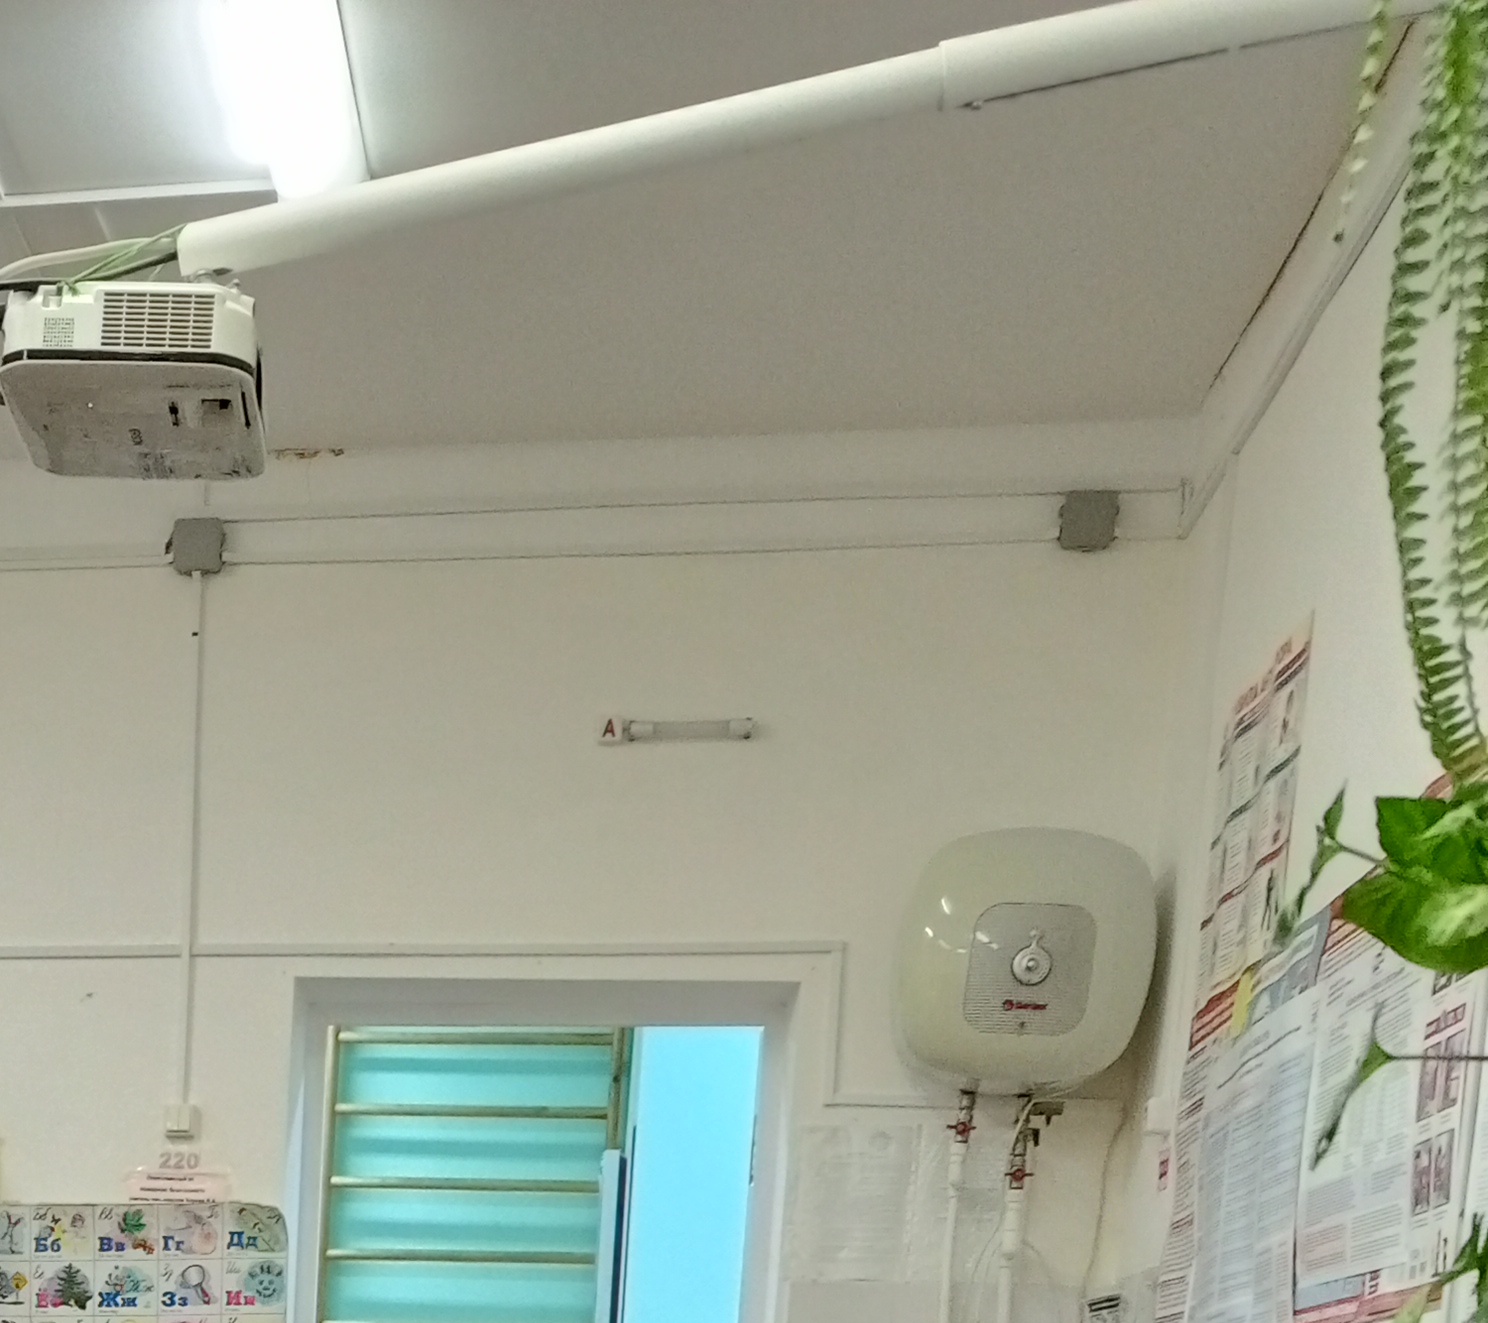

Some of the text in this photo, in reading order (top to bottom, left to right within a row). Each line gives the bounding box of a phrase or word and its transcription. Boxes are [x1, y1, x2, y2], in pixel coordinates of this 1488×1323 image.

[159, 1152, 200, 1169] 220
[33, 1236, 62, 1253] Бб
[162, 1235, 185, 1252] Гг
[226, 1231, 259, 1250] Дд
[97, 1291, 139, 1308] Жж
[161, 1290, 189, 1308] Зз
